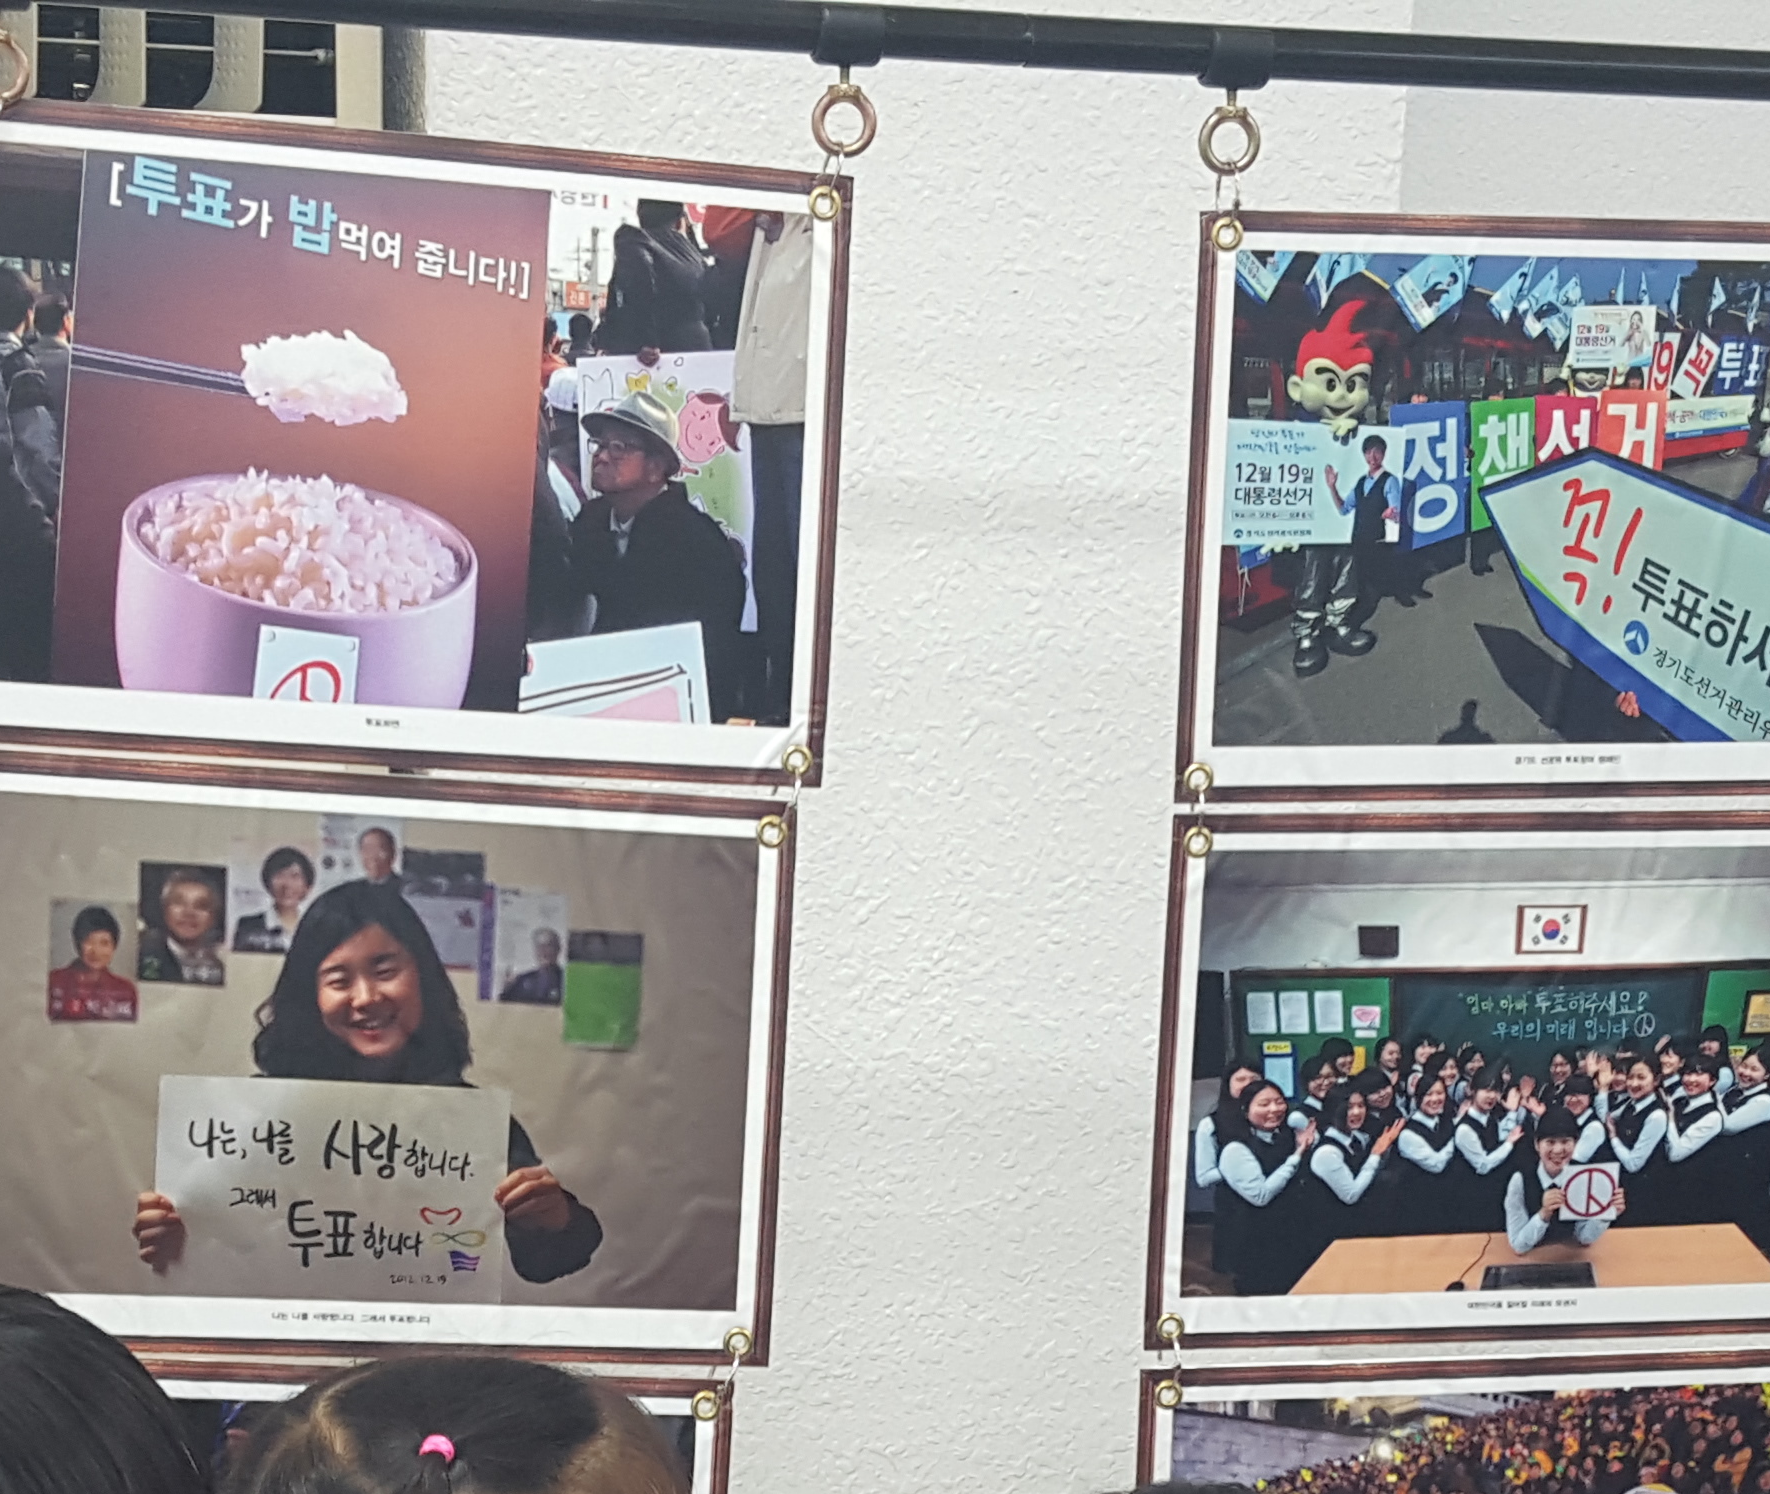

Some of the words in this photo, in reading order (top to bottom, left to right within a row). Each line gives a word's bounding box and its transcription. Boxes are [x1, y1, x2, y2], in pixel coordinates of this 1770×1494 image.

[108, 155, 273, 240] [투표가
[288, 193, 402, 269] 밥먹여
[414, 239, 531, 300] 줍니다!]
[1234, 487, 1313, 506] 대통령선거
[1235, 462, 1271, 483] 12월
[1278, 463, 1314, 484] 19일
[1562, 477, 1643, 615] 꼭!
[1492, 1018, 1541, 1042] 우리의
[1546, 1018, 1576, 1040] 미래
[1584, 1017, 1629, 1041] 입니다
[188, 1117, 247, 1160] 나는,
[323, 1118, 475, 1182] 사랑합니다.
[287, 1199, 424, 1268] 투표합니다
